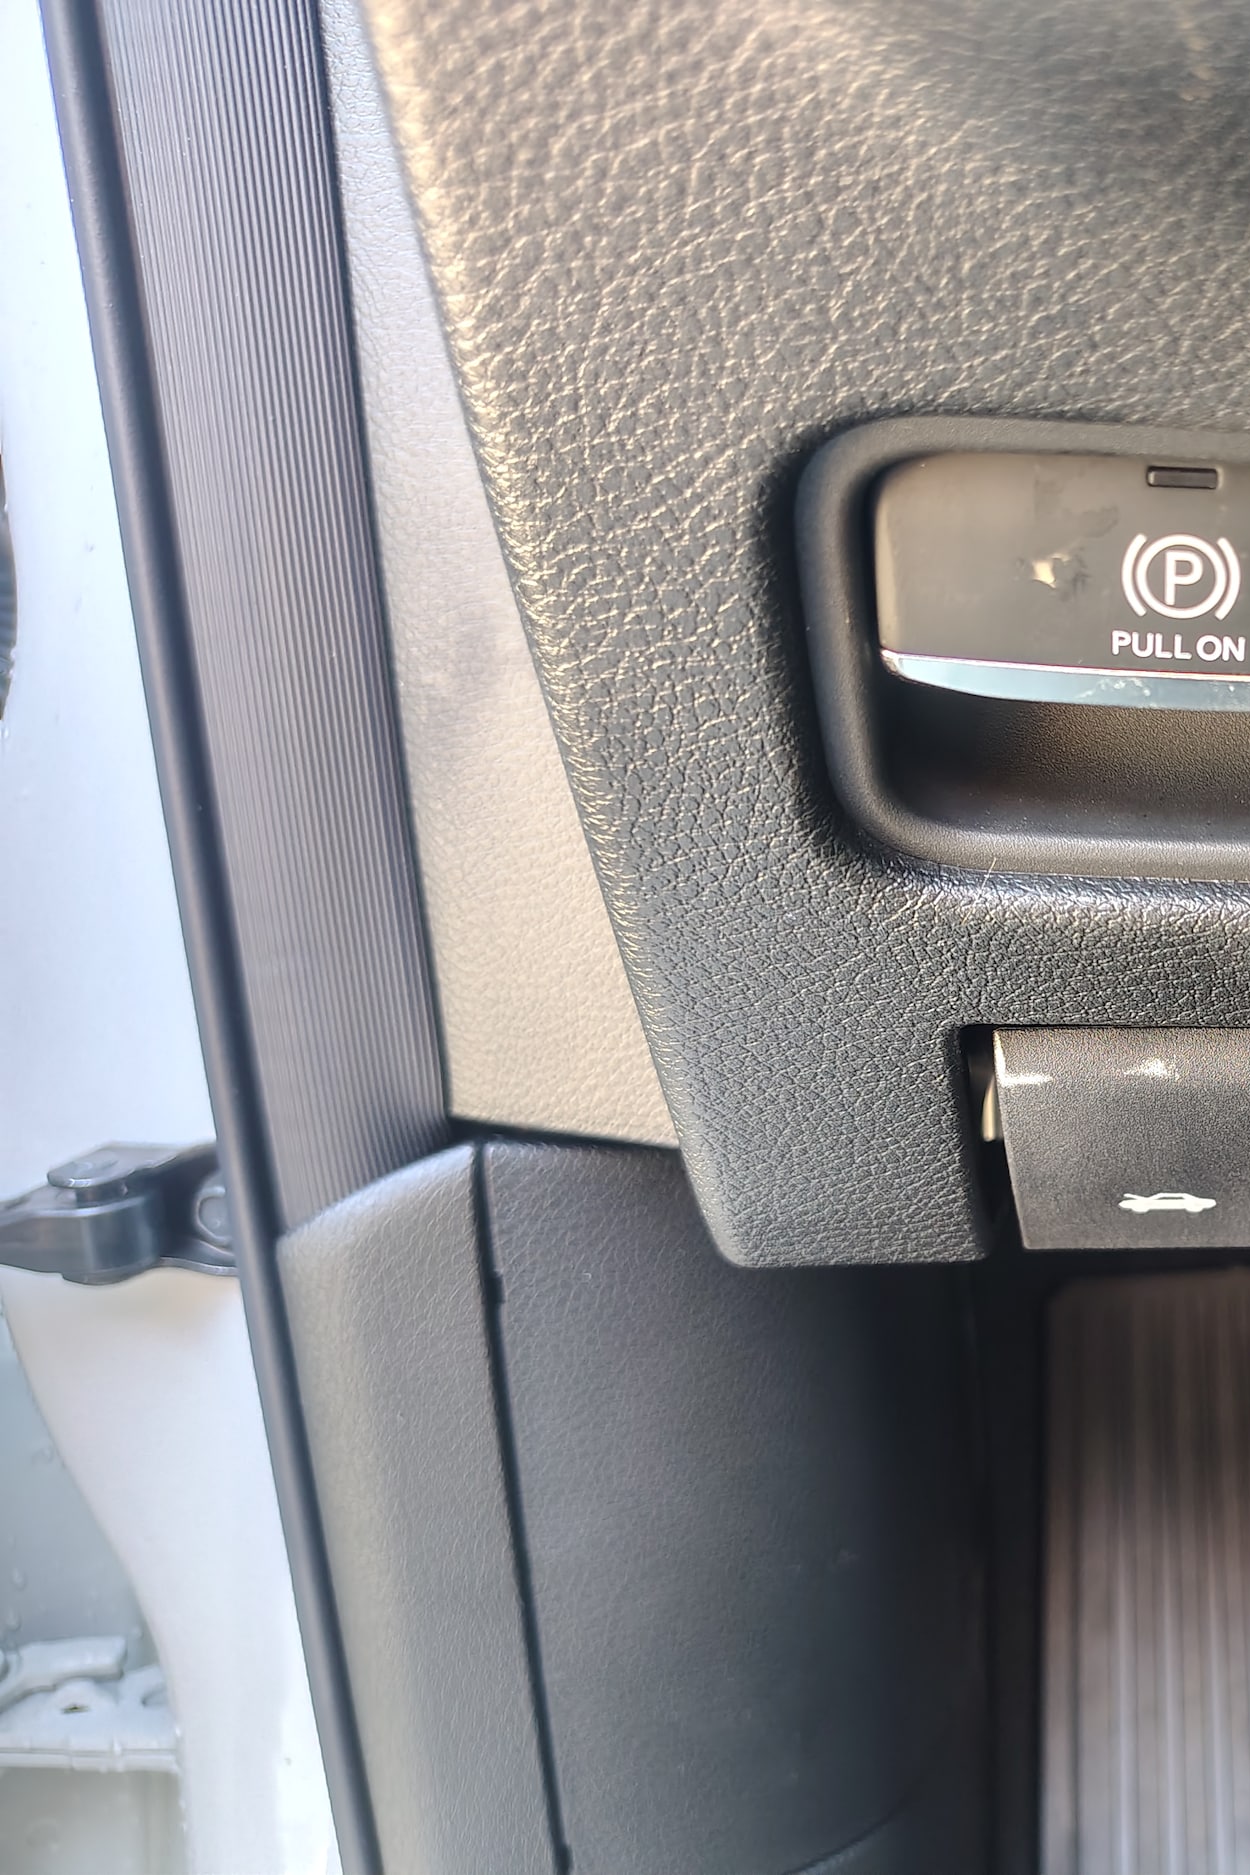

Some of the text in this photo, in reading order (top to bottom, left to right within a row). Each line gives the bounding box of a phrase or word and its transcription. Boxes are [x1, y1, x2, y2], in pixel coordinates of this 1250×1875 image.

[1165, 550, 1204, 605] P
[1111, 629, 1246, 662] PULL ON
